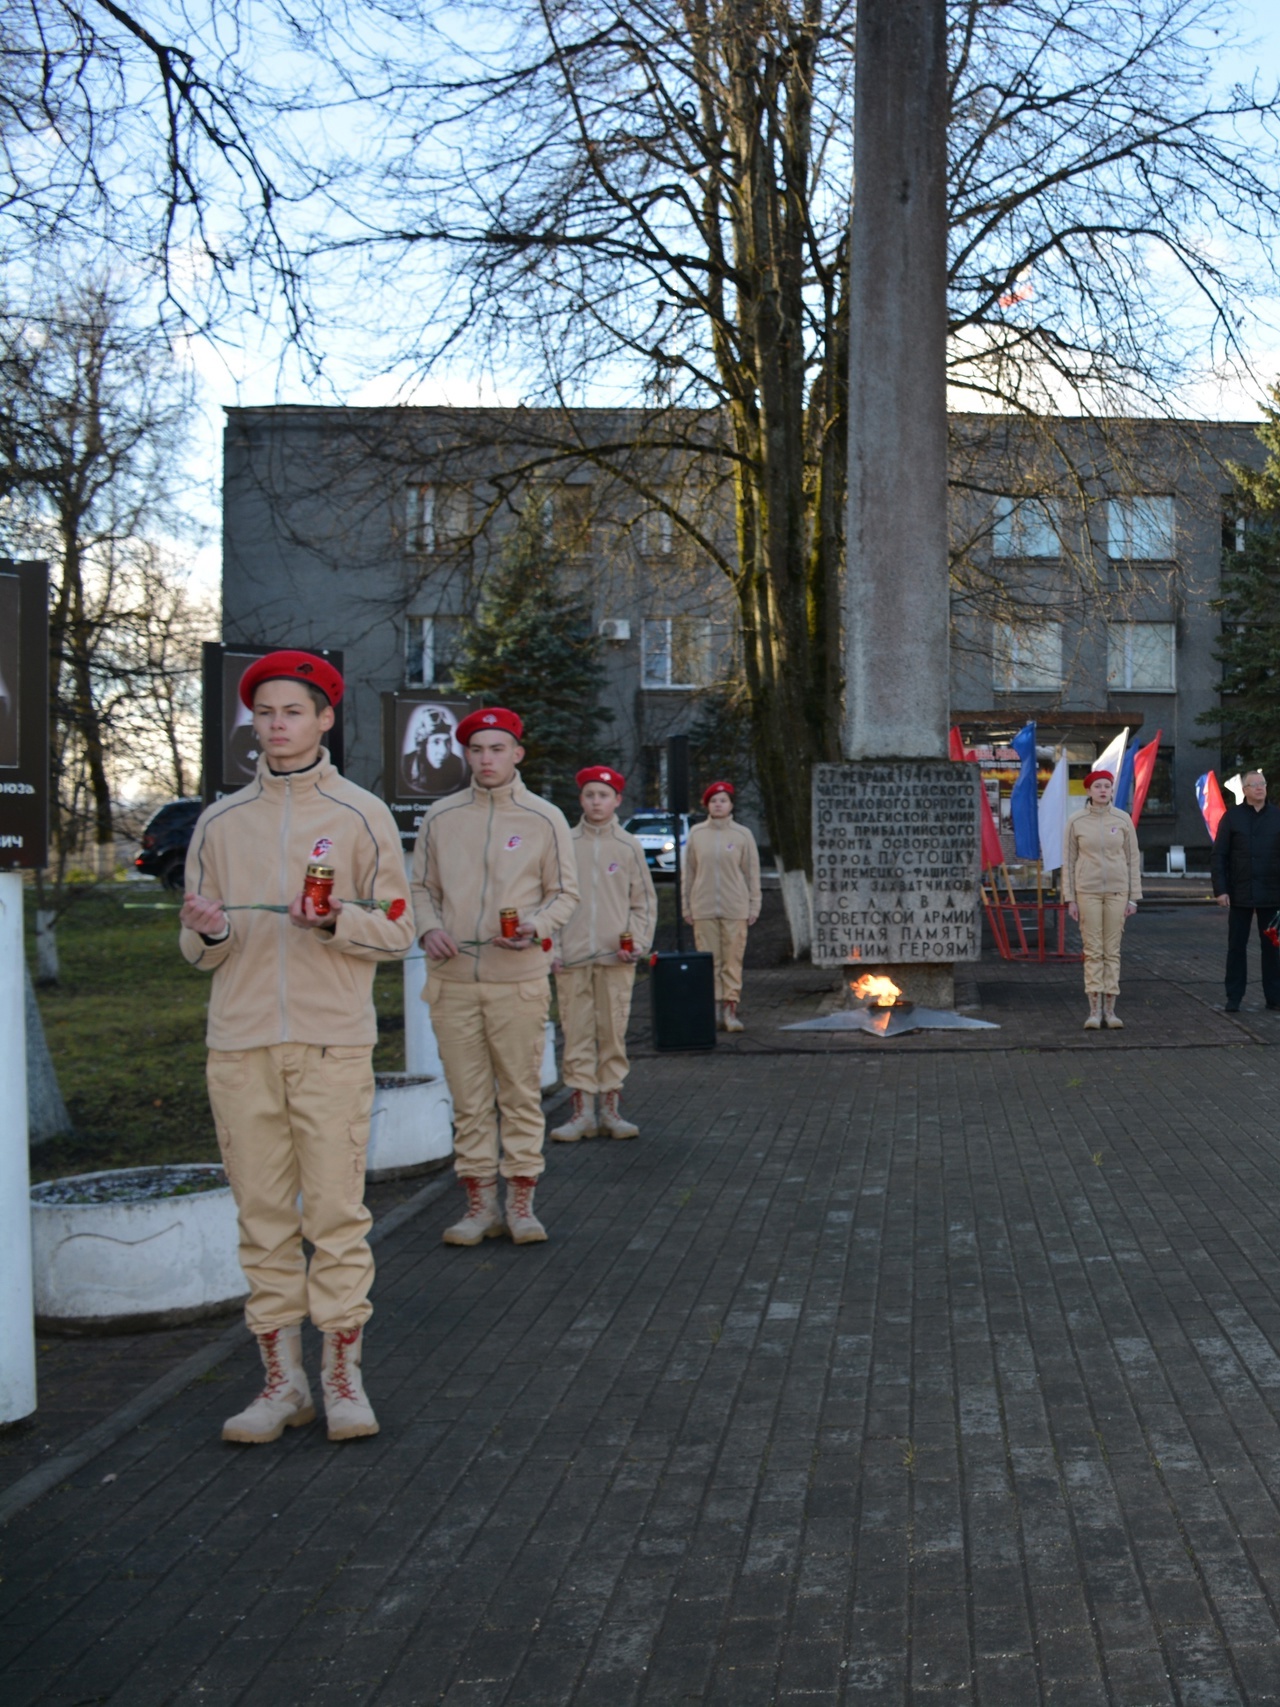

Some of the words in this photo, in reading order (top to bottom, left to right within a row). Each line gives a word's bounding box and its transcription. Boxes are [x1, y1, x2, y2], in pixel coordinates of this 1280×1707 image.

[899, 768, 932, 783] 1944
[817, 784, 857, 797] ЧАСТИ
[871, 784, 975, 797] ГВАРДЕЙСКОГО
[817, 798, 910, 810] СТРЕЛКОВОГО
[914, 798, 974, 809] КОРПУСА
[817, 810, 832, 823] 10
[838, 810, 928, 823] ГВАРДЕЙСКОЙ
[934, 811, 975, 823] АРМИИ
[854, 824, 975, 837] ПРИБАЛТИЙСКОГО
[817, 838, 873, 850] ФРОНТА
[881, 838, 976, 850] ОСВОБОДИЛИ
[817, 854, 871, 866] ГОРОД
[878, 851, 974, 865] ПУСТОШКУ
[817, 867, 836, 879] ОТ
[817, 881, 858, 892] СКИХ
[870, 879, 973, 892] ЗАХВАТЧИКОВ
[817, 909, 914, 925] СОВЕТСКОЙ
[923, 911, 975, 924] АРМИИ
[817, 927, 888, 942] ВЕЧНАЯ
[901, 926, 976, 940] ПАМЯТЬ
